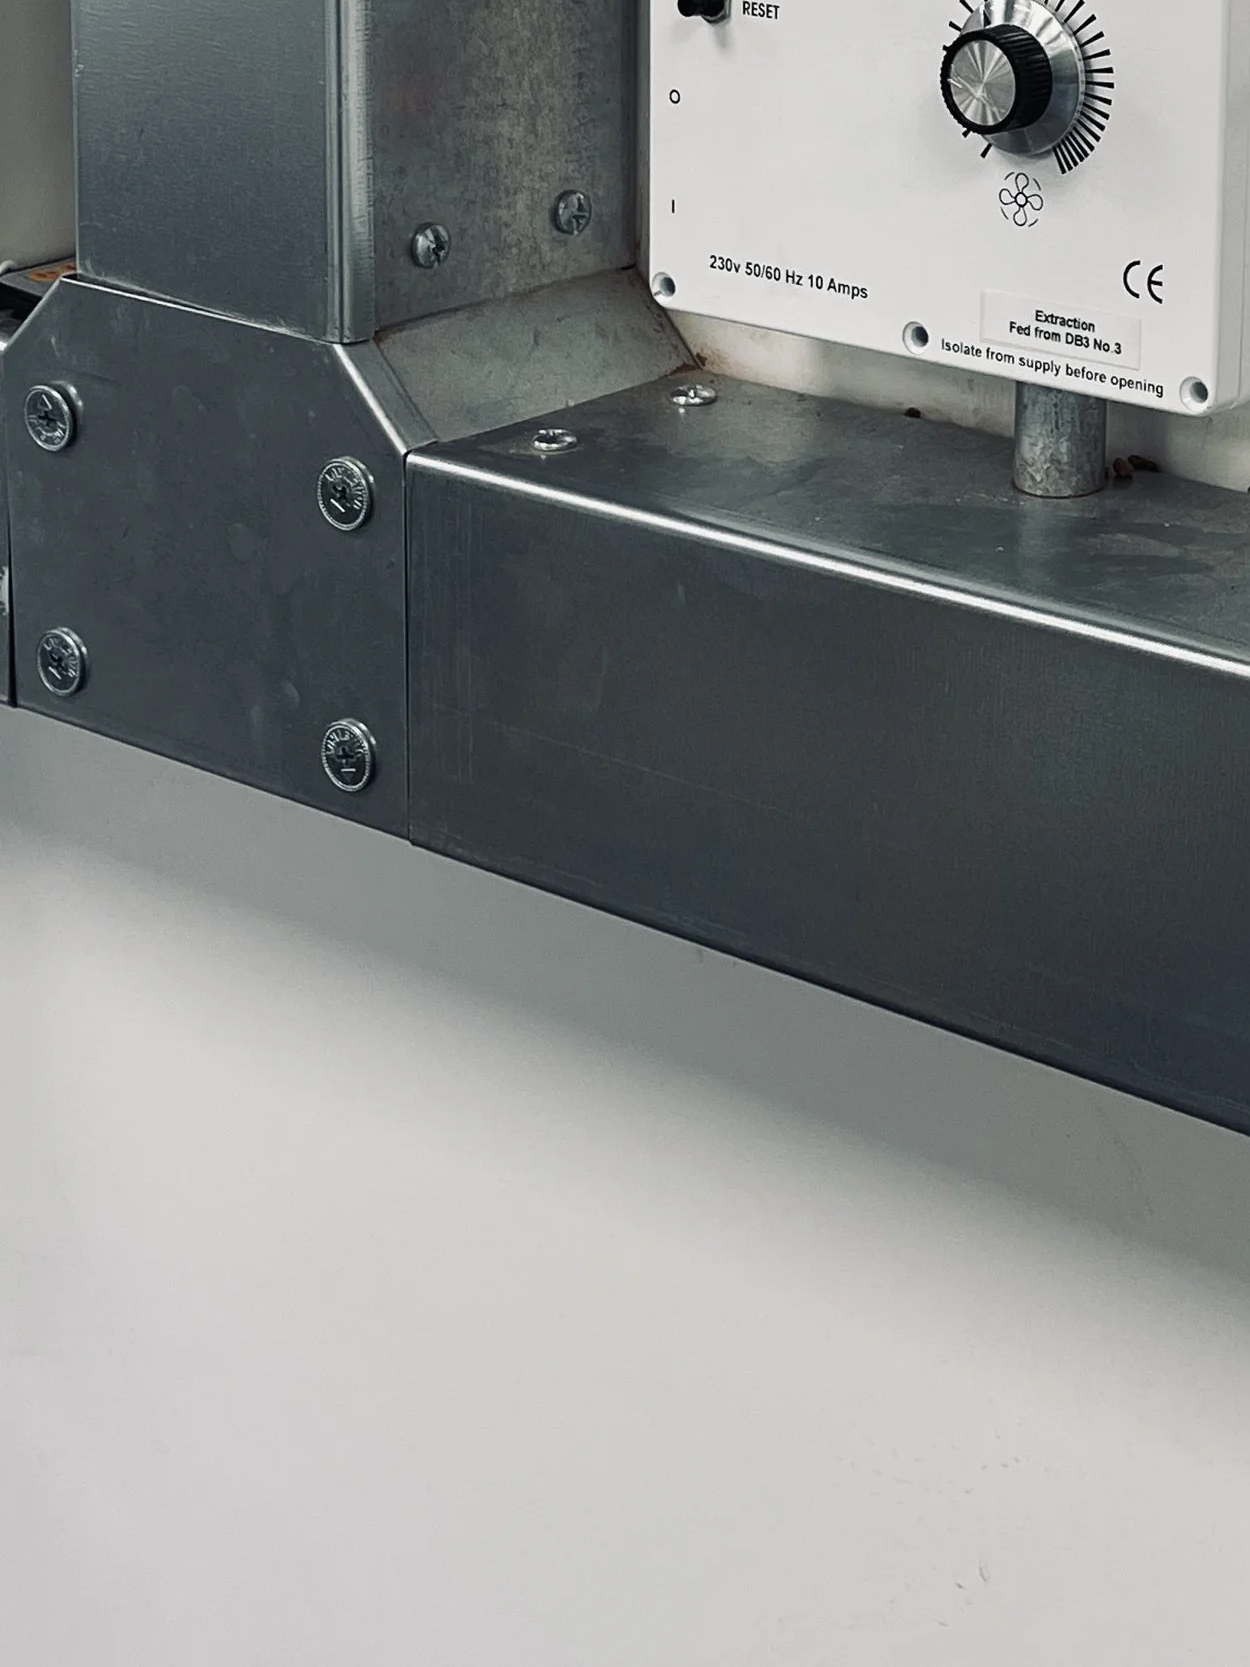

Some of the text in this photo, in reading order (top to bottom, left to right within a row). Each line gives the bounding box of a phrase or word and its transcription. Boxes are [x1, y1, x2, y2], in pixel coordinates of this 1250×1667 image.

[742, 0, 780, 20] RESET
[709, 254, 869, 300] 230v 50/60 Hz 10 Amps
[1008, 320, 1032, 338] Fed
[1033, 326, 1062, 343] from
[1064, 334, 1091, 350] DB3
[1034, 309, 1096, 333] Extraction
[941, 337, 1165, 399] Isolate from supply before opening
